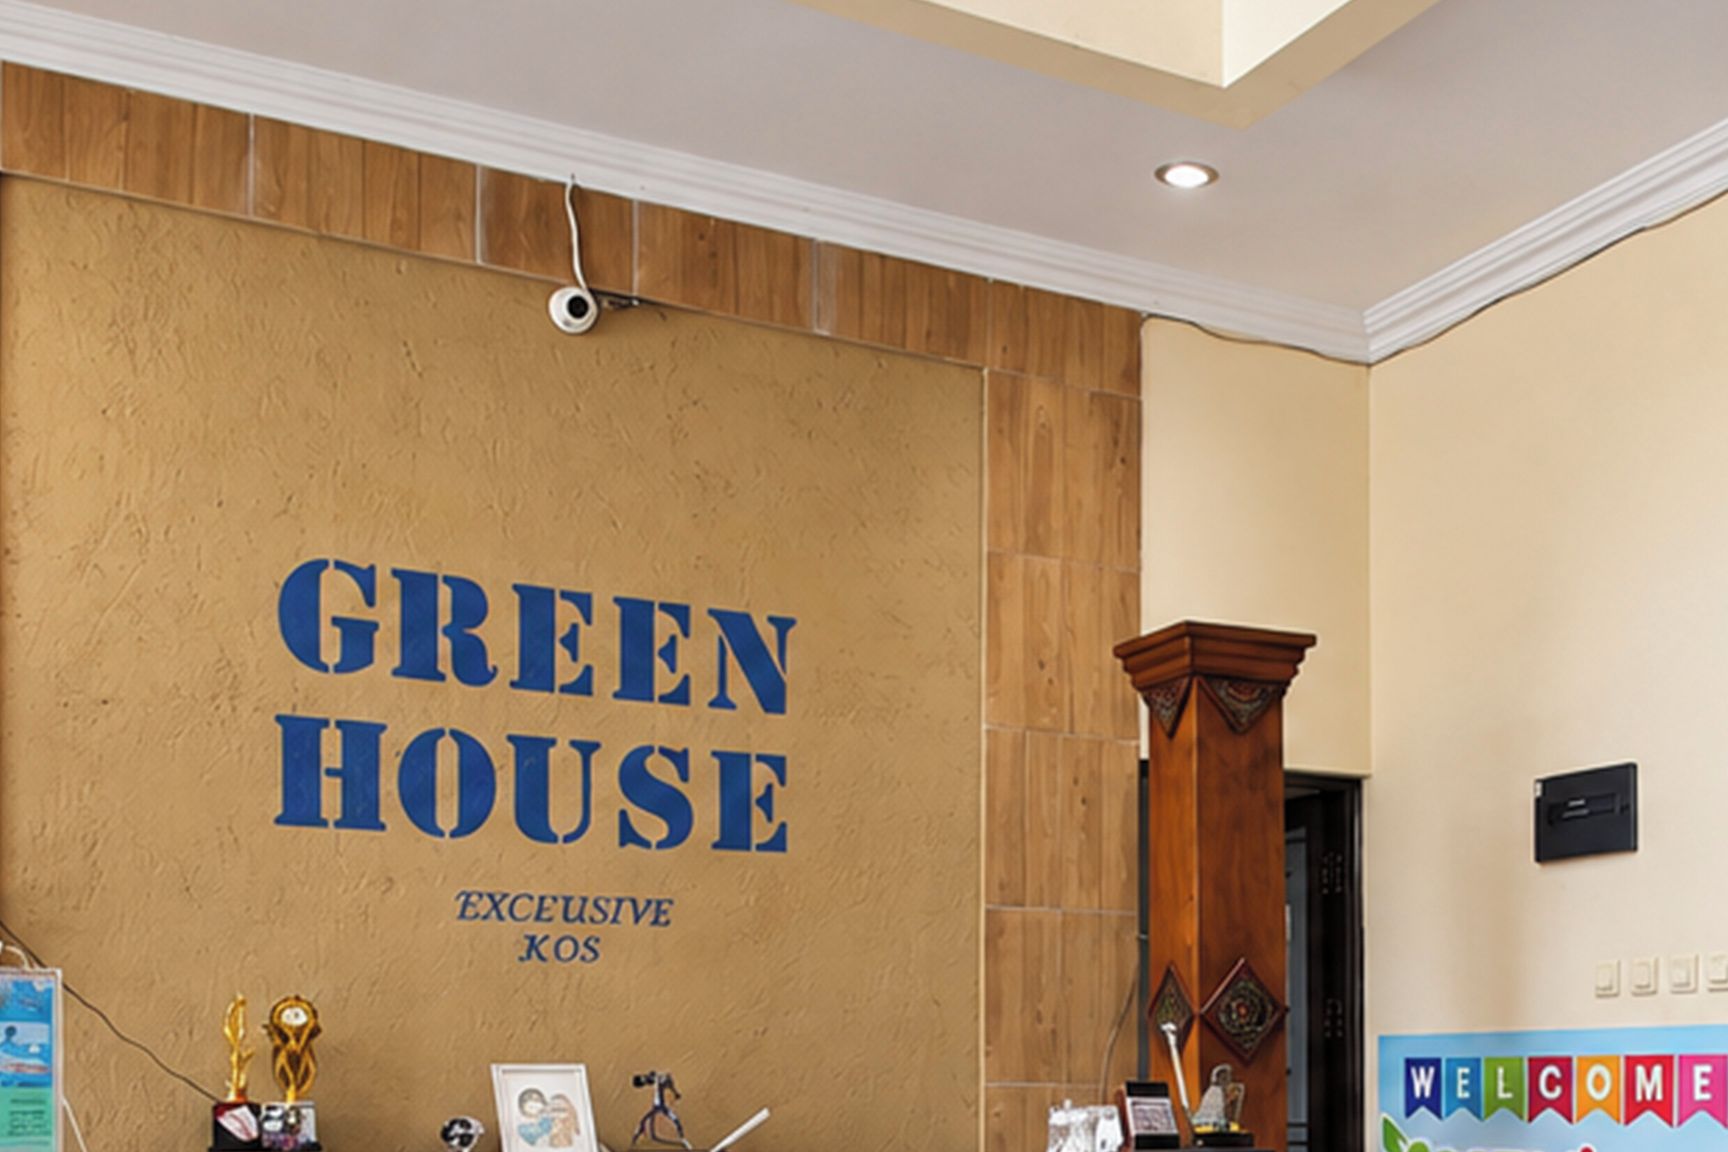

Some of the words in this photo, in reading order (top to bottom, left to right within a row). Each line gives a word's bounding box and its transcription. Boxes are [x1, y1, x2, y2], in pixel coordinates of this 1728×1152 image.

[278, 558, 796, 714] GREEN
[274, 714, 787, 853] HOUSE
[517, 933, 601, 963] KOS
[1411, 1064, 1713, 1102] WELCOME
